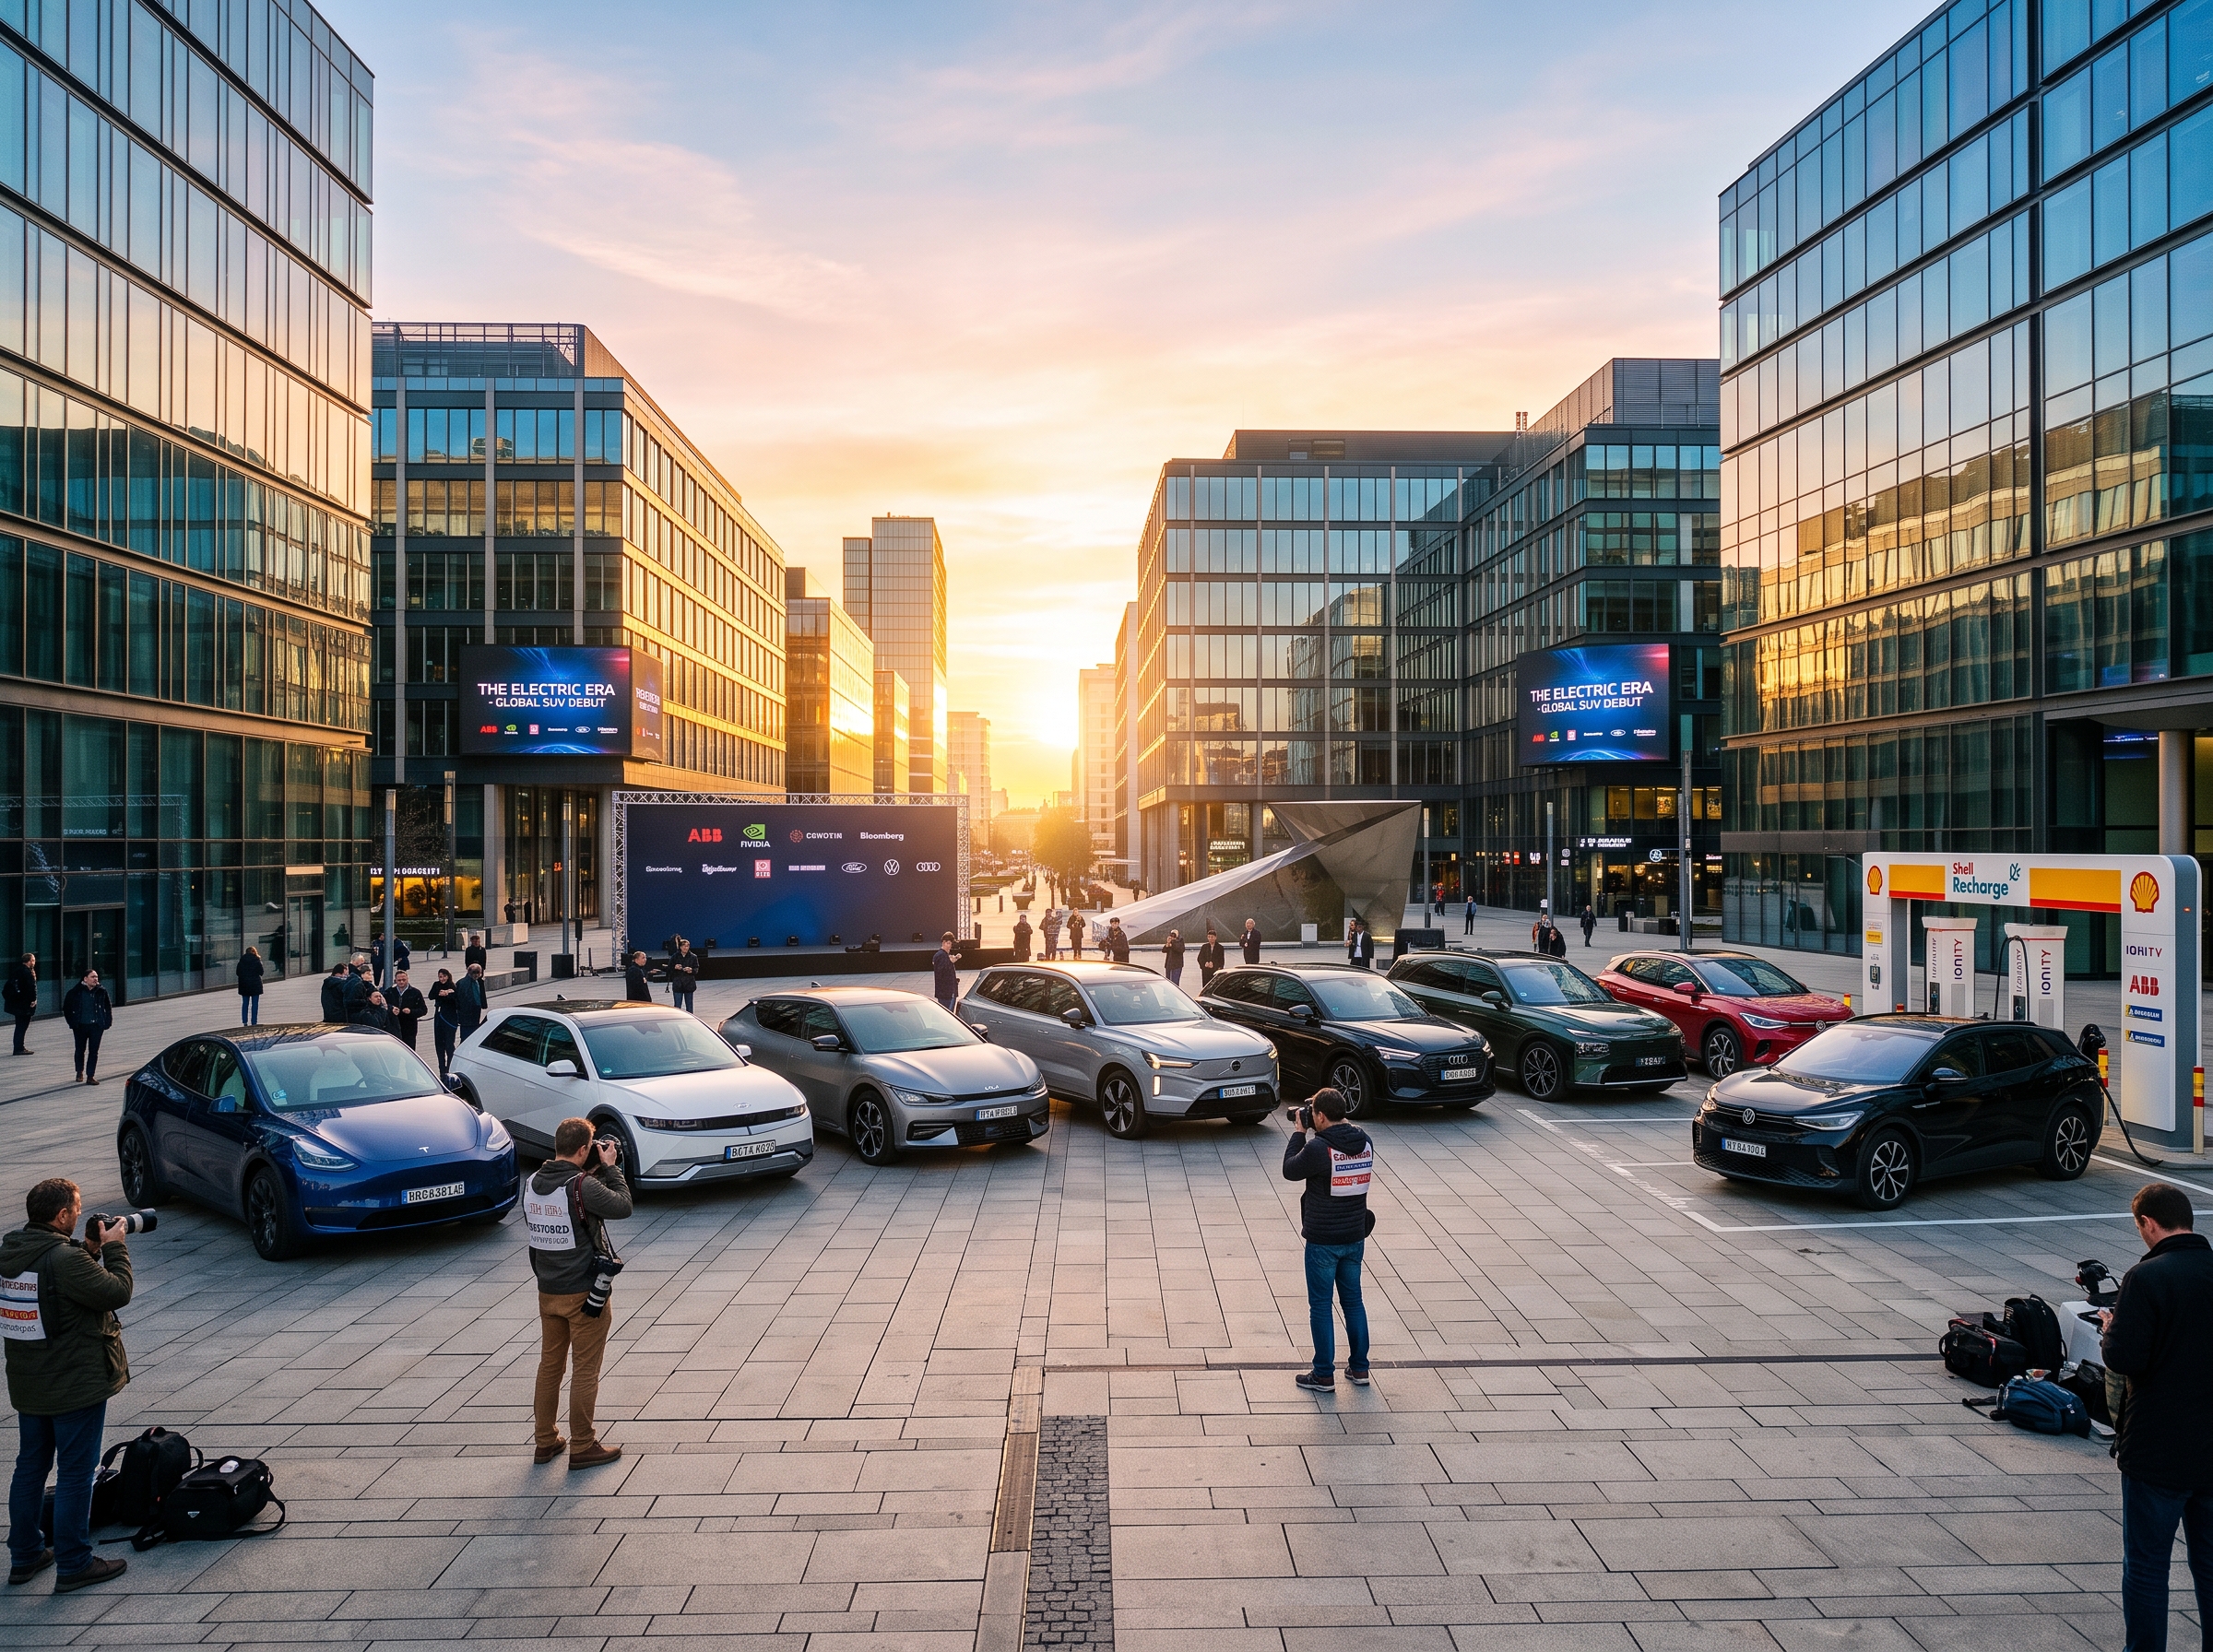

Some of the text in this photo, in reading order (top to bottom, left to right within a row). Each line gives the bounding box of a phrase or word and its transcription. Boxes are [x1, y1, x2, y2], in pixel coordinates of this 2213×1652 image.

[478, 683, 615, 696] THE ELECTRIC ERA
[1530, 681, 1653, 702] THE ELECTRIC ERA
[495, 698, 540, 708] GLOBAL
[542, 698, 565, 708] SUV
[568, 698, 606, 708] DEBUT
[1541, 702, 1577, 714] GLOBAL
[1579, 699, 1602, 711] SUV
[1604, 697, 1643, 708] DEBUT
[480, 726, 498, 734] ABB
[688, 829, 723, 843] ABB
[859, 832, 905, 842] Bloomberg
[1952, 862, 1974, 875] Shell
[1953, 876, 2009, 900] Recharge
[2129, 974, 2160, 997] ABB
